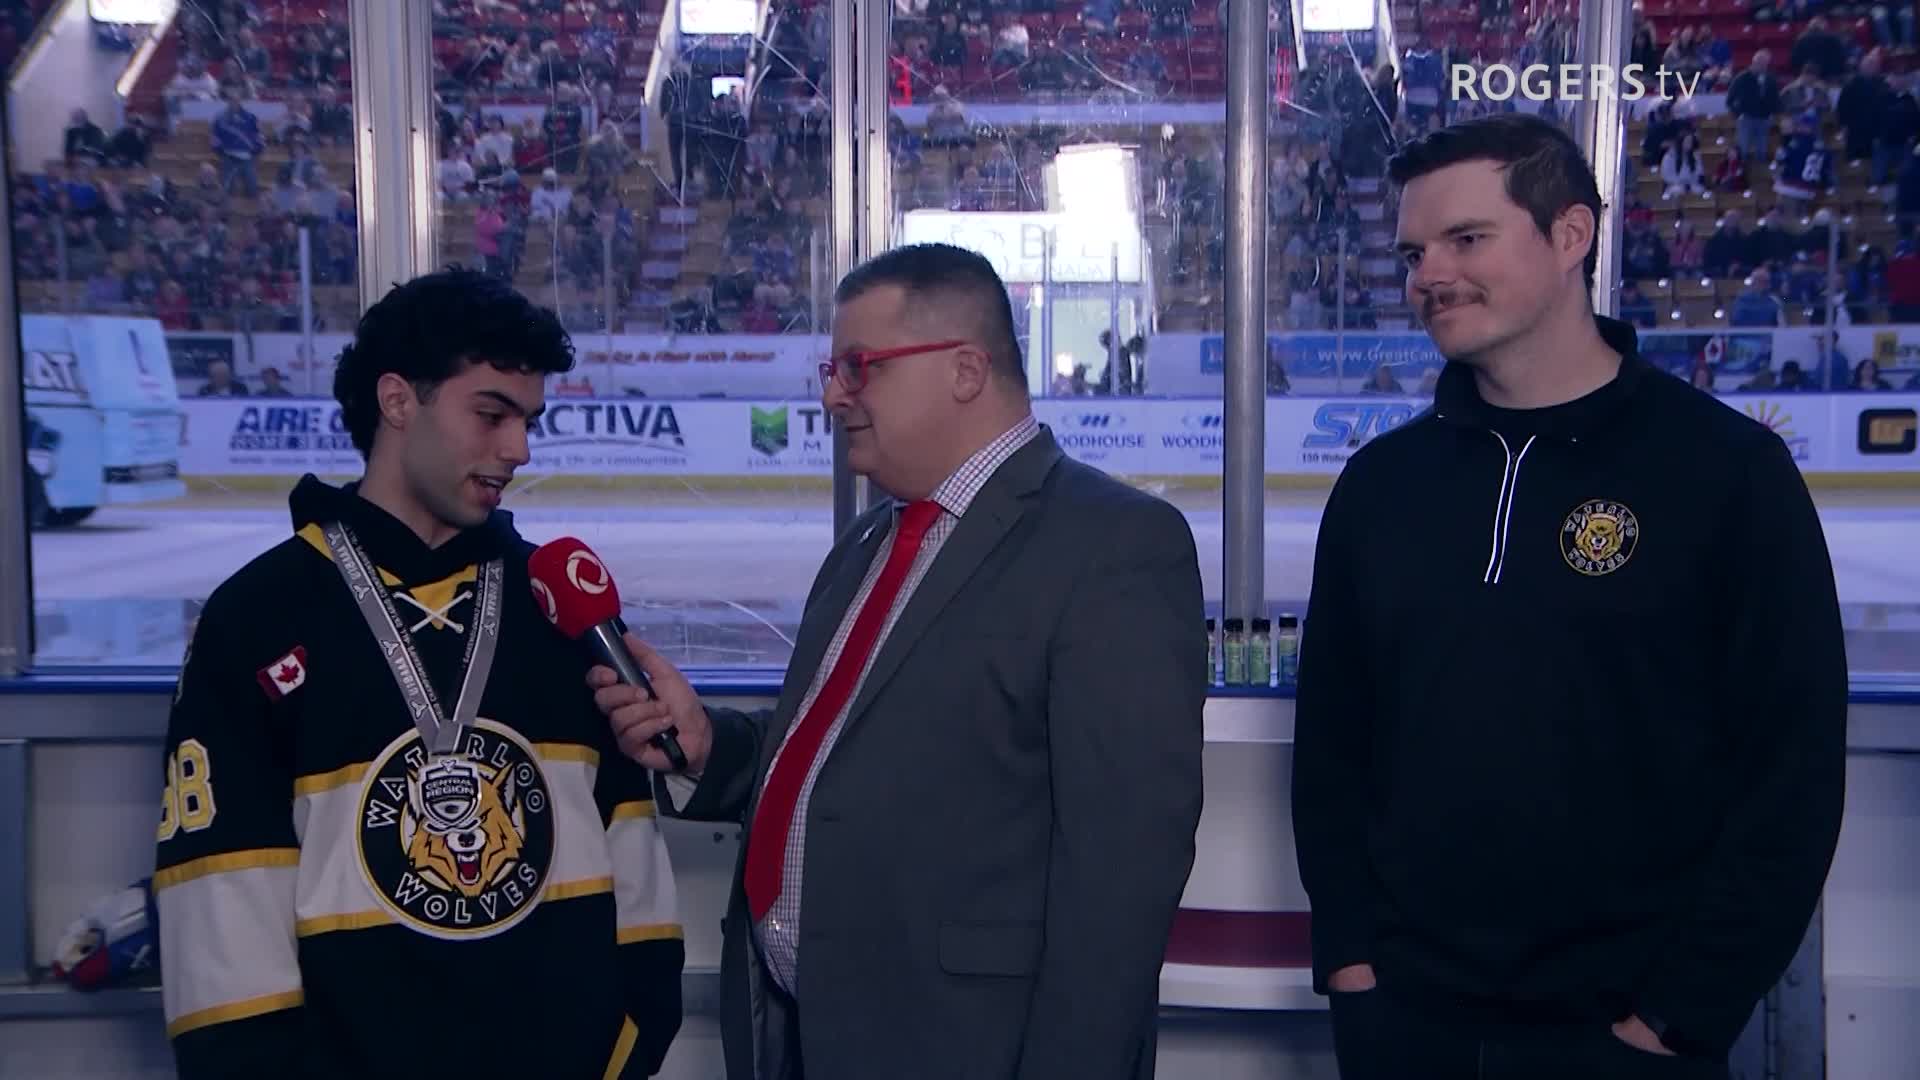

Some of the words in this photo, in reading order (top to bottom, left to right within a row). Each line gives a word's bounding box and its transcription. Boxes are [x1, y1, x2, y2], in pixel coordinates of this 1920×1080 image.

[24, 351, 80, 392] AT
[236, 407, 322, 433] AIRE
[526, 404, 682, 438] ACTIVA
[1055, 434, 1145, 448] OODHOUSE
[1161, 434, 1222, 448] WOODH
[366, 733, 545, 828] WATRLOO
[395, 864, 537, 923] WOLVES
